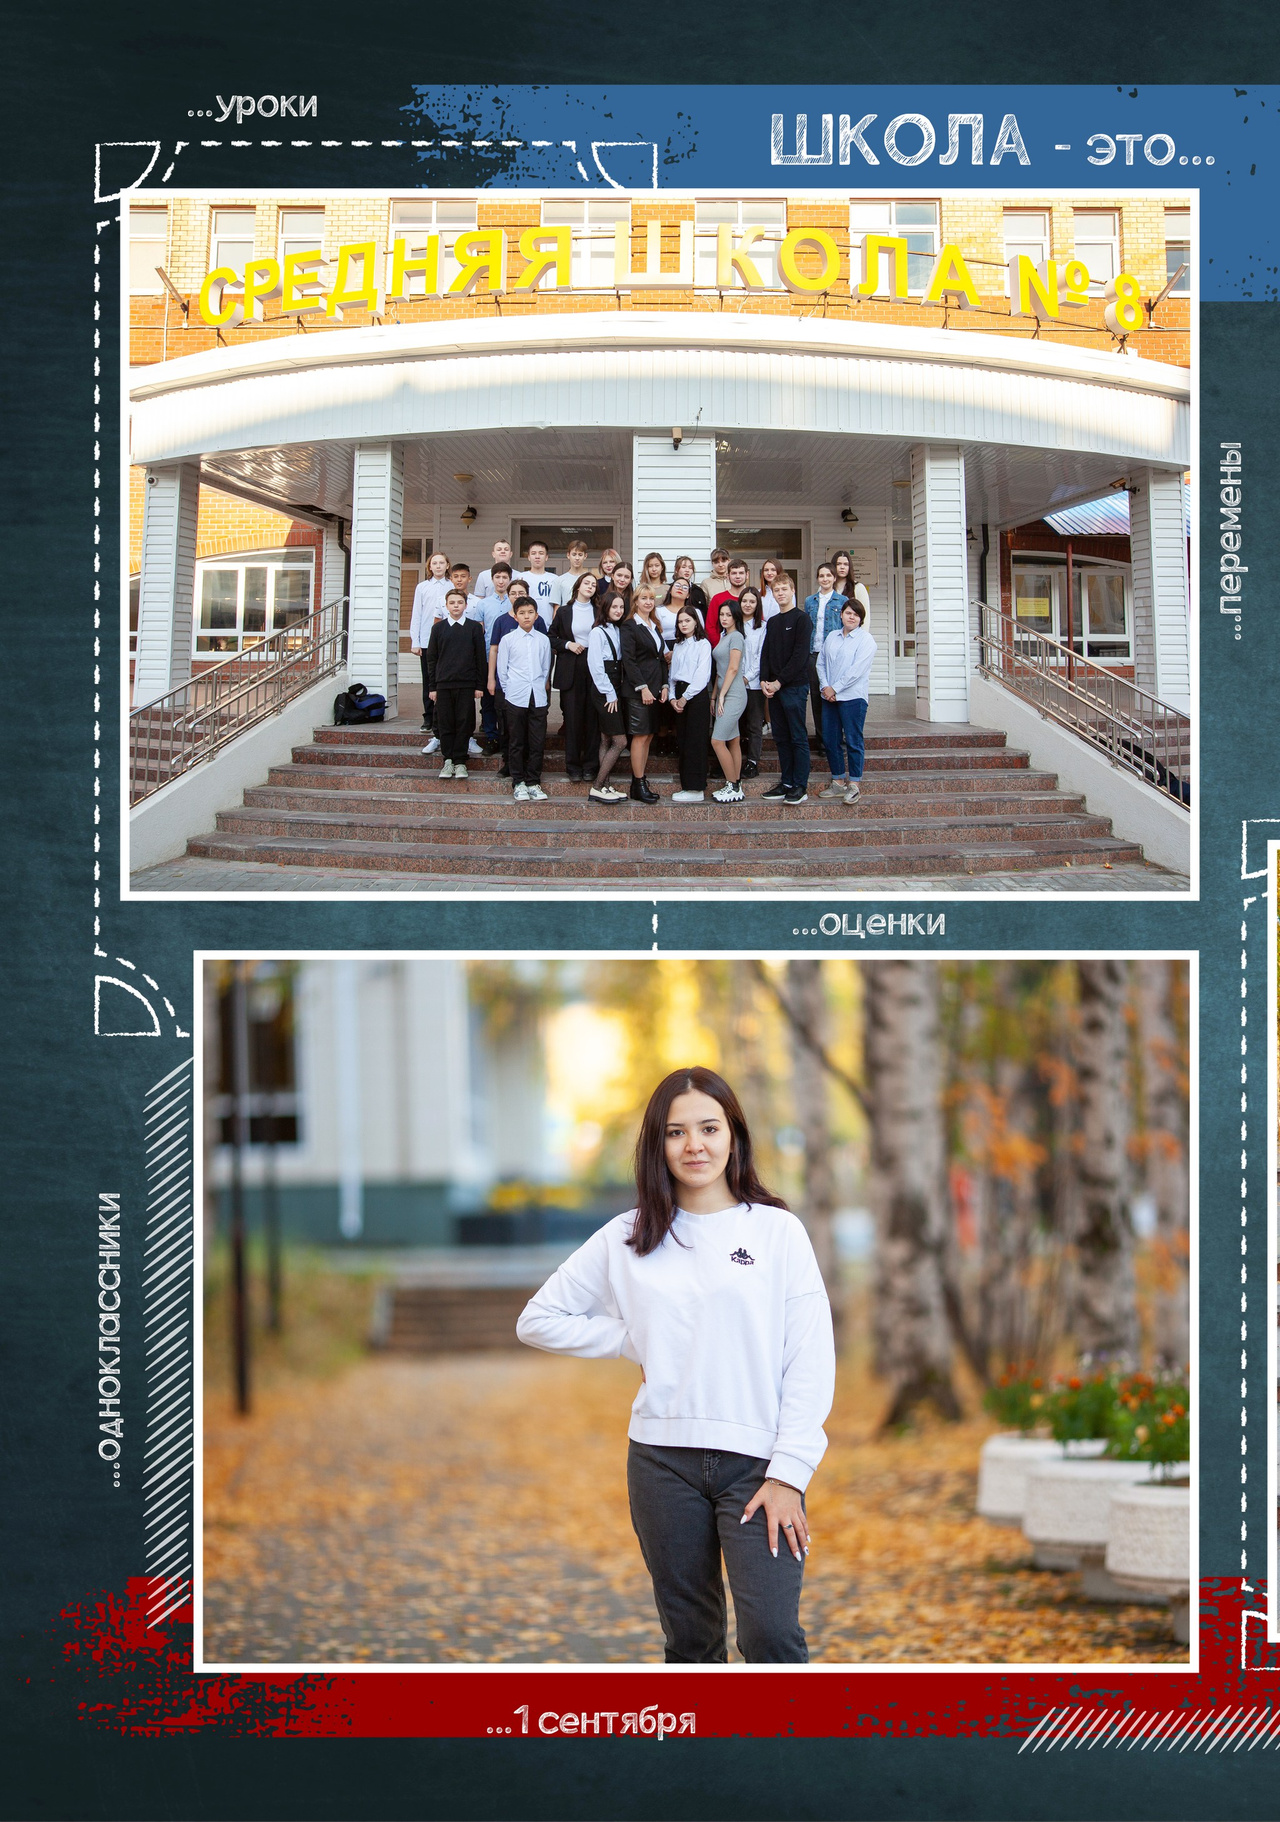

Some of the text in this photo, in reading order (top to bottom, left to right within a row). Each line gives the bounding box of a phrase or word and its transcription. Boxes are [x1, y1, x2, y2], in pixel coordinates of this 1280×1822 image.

[198, 226, 573, 328] СРЕДНЯЯ
[614, 220, 981, 311] ШКОЛА
[1105, 273, 1143, 335] 8
